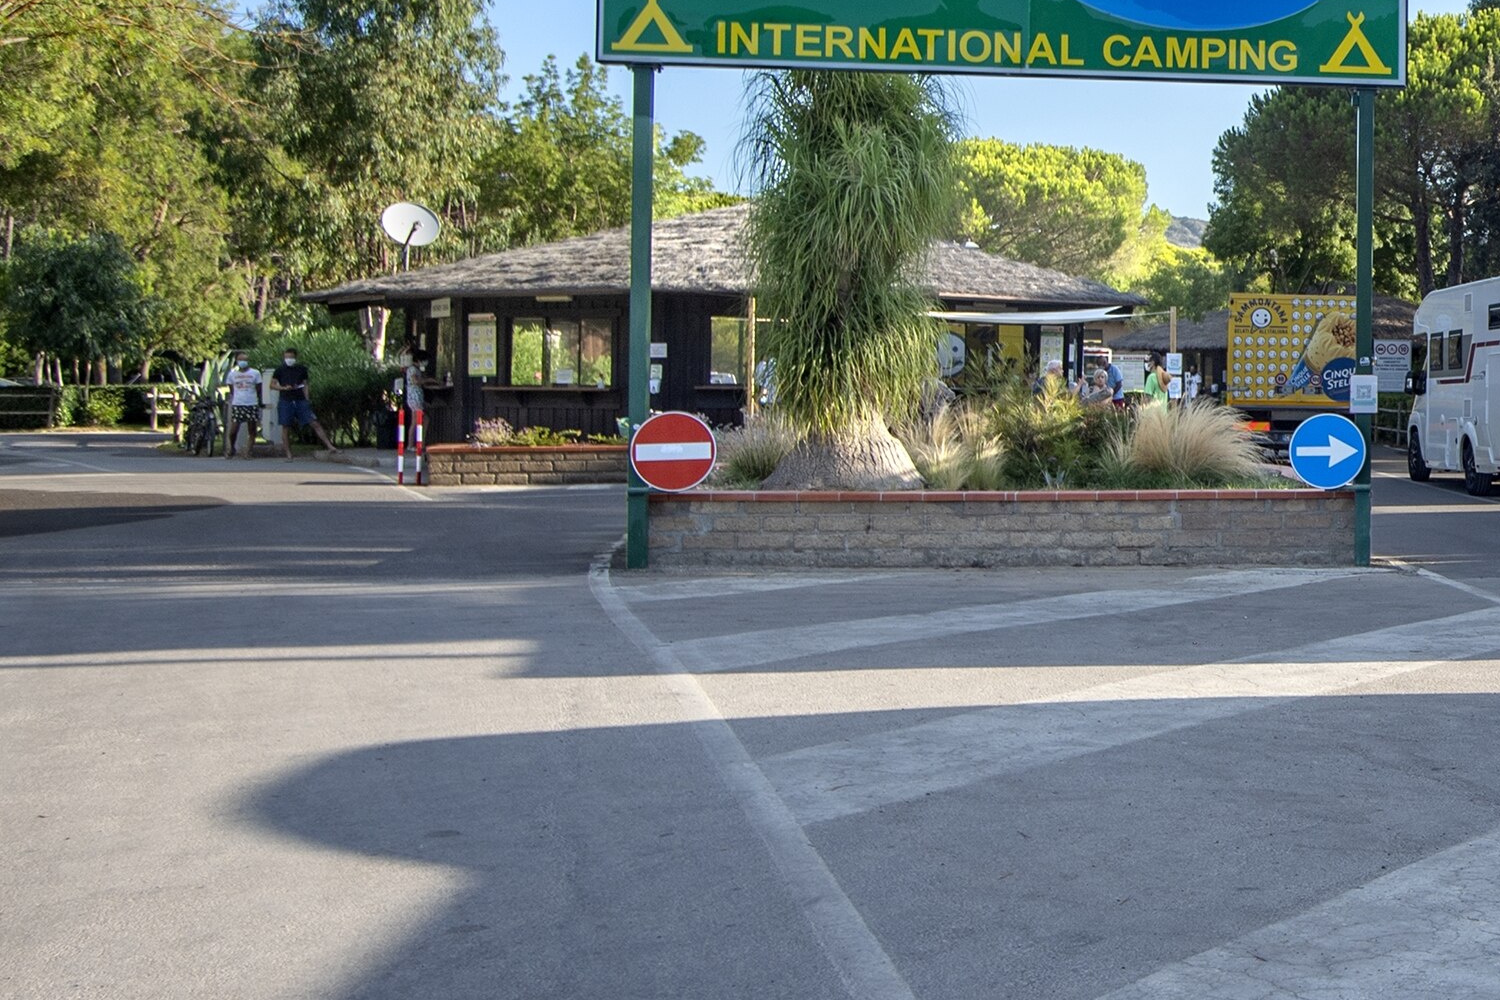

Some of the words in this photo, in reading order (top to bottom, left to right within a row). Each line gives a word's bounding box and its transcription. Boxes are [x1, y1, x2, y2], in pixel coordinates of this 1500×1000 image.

[716, 20, 1085, 68] INTERNATIONAL
[1103, 33, 1299, 73] CAMPING
[1234, 298, 1288, 324] SAMMONTANA
[1323, 367, 1356, 381] CINQU
[1327, 378, 1351, 390] STEL
